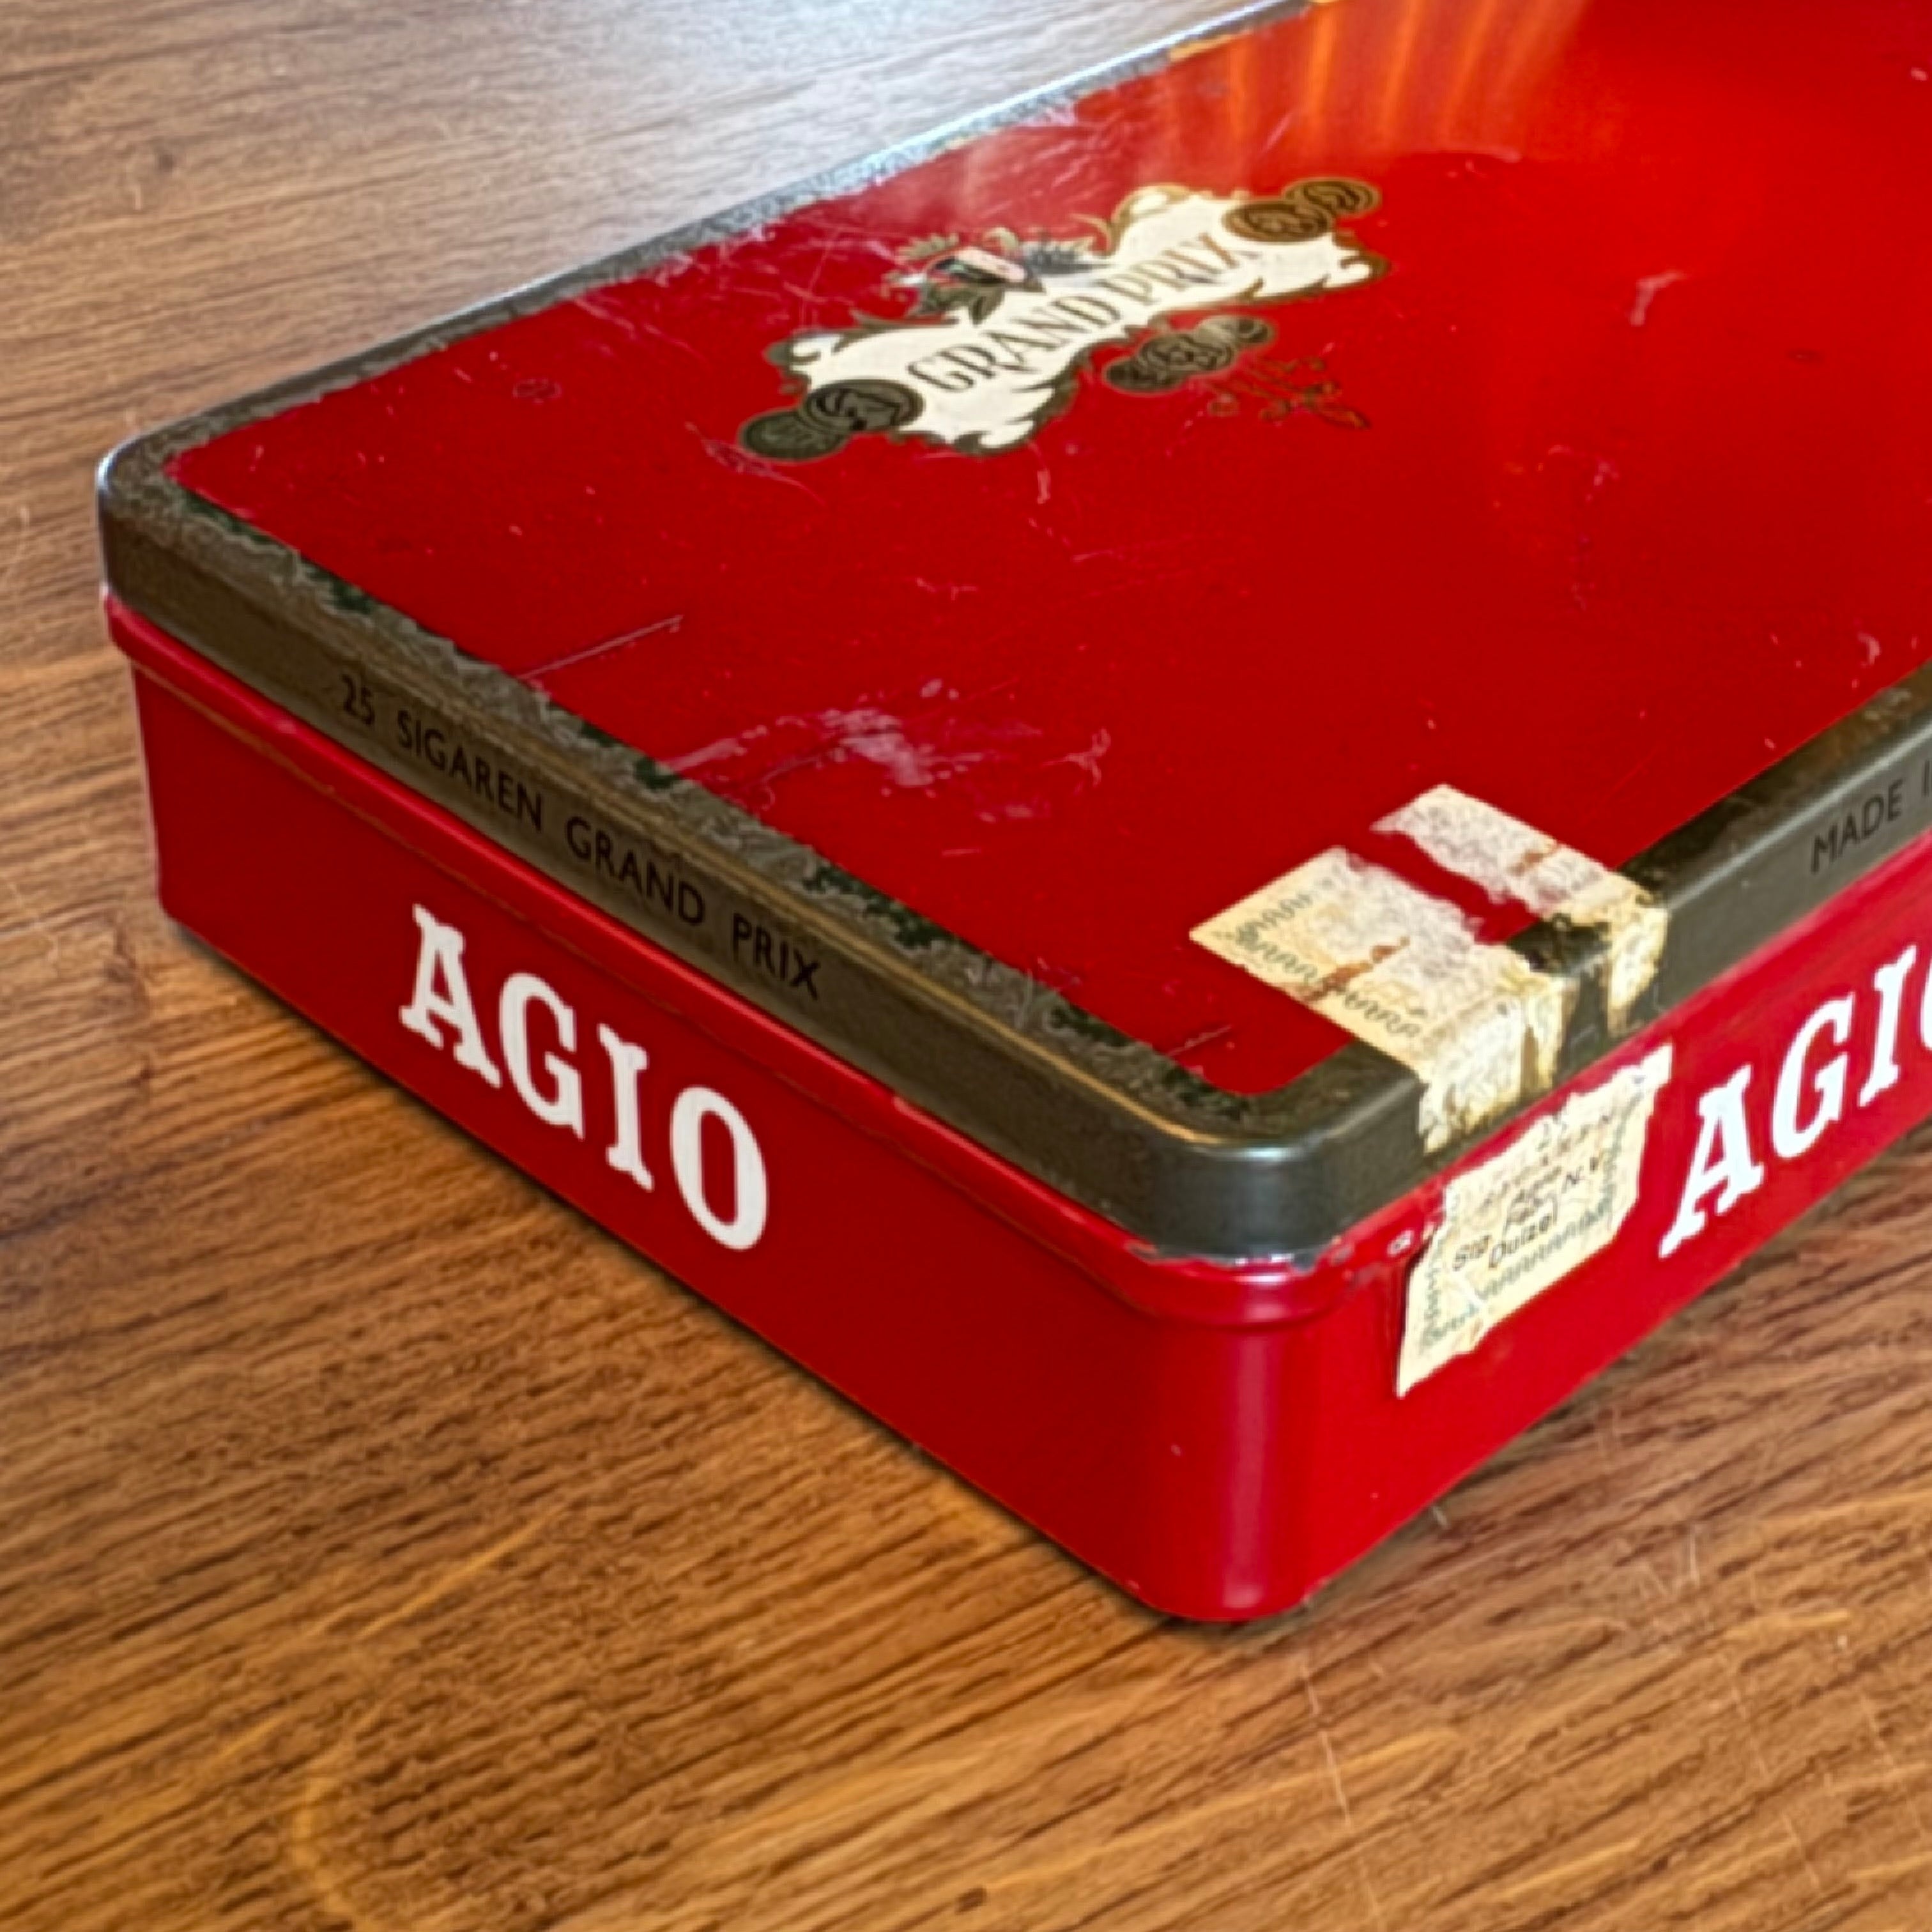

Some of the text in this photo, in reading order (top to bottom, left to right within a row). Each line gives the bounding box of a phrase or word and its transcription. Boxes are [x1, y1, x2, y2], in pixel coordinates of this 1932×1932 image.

[905, 233, 1260, 392] GRAND PRIX
[340, 675, 820, 1001] 25 SIGAREN GRAND PRIX
[1811, 777, 1905, 874] MADE
[399, 903, 769, 1251] AGIO
[1659, 942, 1932, 1259] AGI
